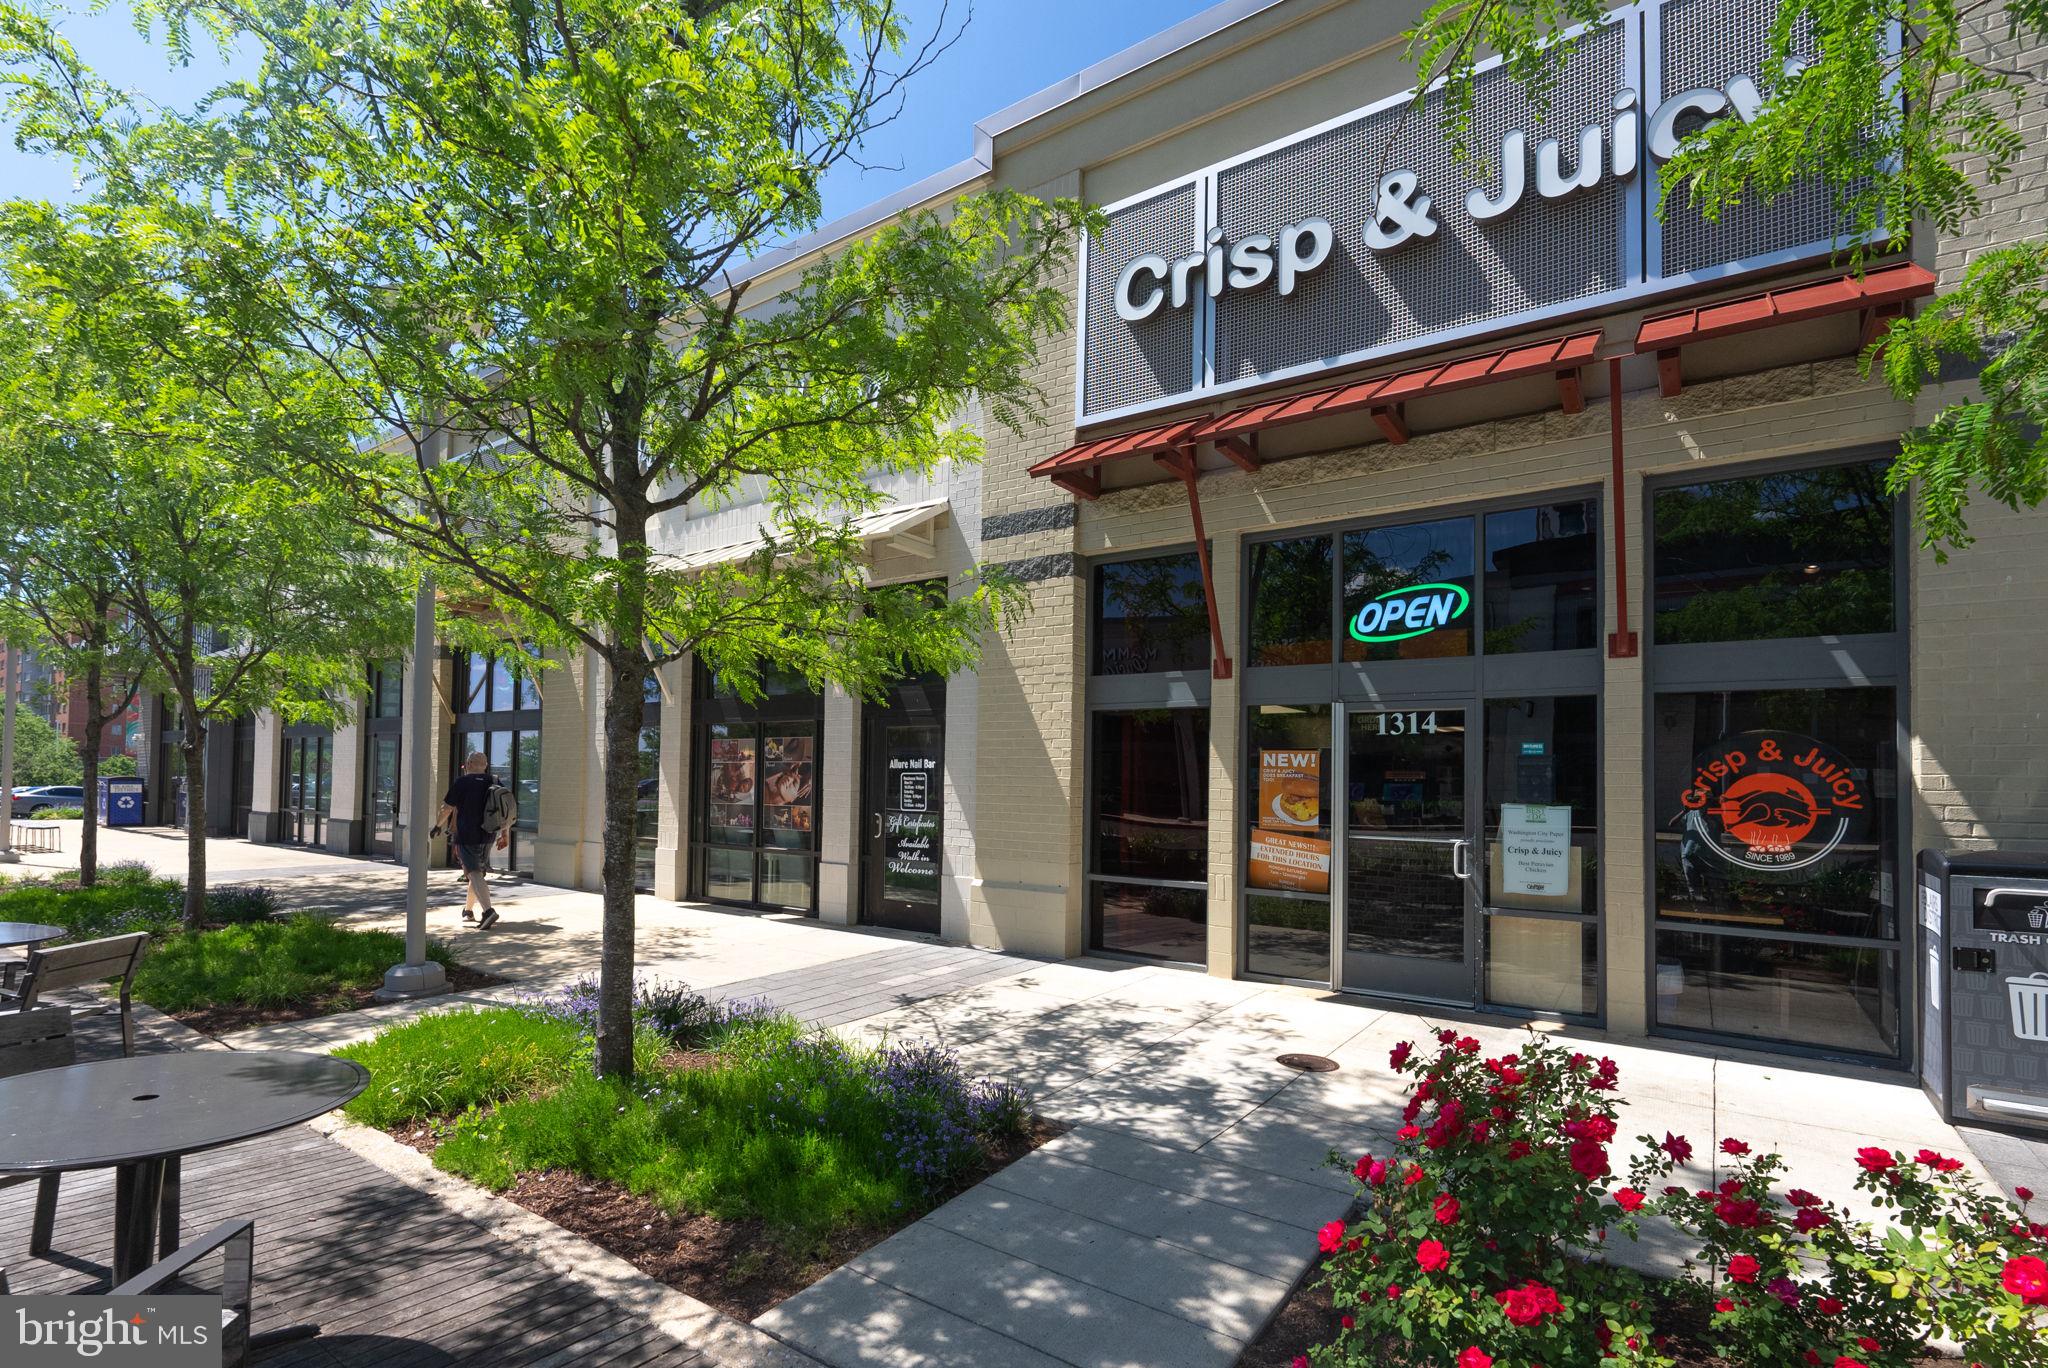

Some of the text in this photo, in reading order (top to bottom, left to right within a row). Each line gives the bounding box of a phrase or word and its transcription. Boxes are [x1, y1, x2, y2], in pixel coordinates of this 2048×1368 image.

[1113, 216, 1334, 323] Crisp
[1361, 168, 1438, 253] &
[1357, 593, 1455, 633] OPEN
[1376, 711, 1437, 735] 1314
[889, 759, 936, 768] Allure Nail Bar
[1263, 753, 1316, 767] NEW!
[1681, 739, 1864, 811] Crisp & Juicy
[889, 814, 935, 835] Gift Certificates
[898, 835, 929, 848] Available
[1265, 836, 1287, 845] GREAT
[898, 850, 920, 861] Walk
[1260, 846, 1320, 861] EXTENDED HOURS
[1507, 846, 1563, 857] Crisp & Juicy
[1745, 851, 1796, 863] SINCE 1989
[1257, 852, 1323, 870] FOR THIS LOCATION
[889, 862, 934, 875] Welcome
[1990, 932, 2041, 945] TRASH
